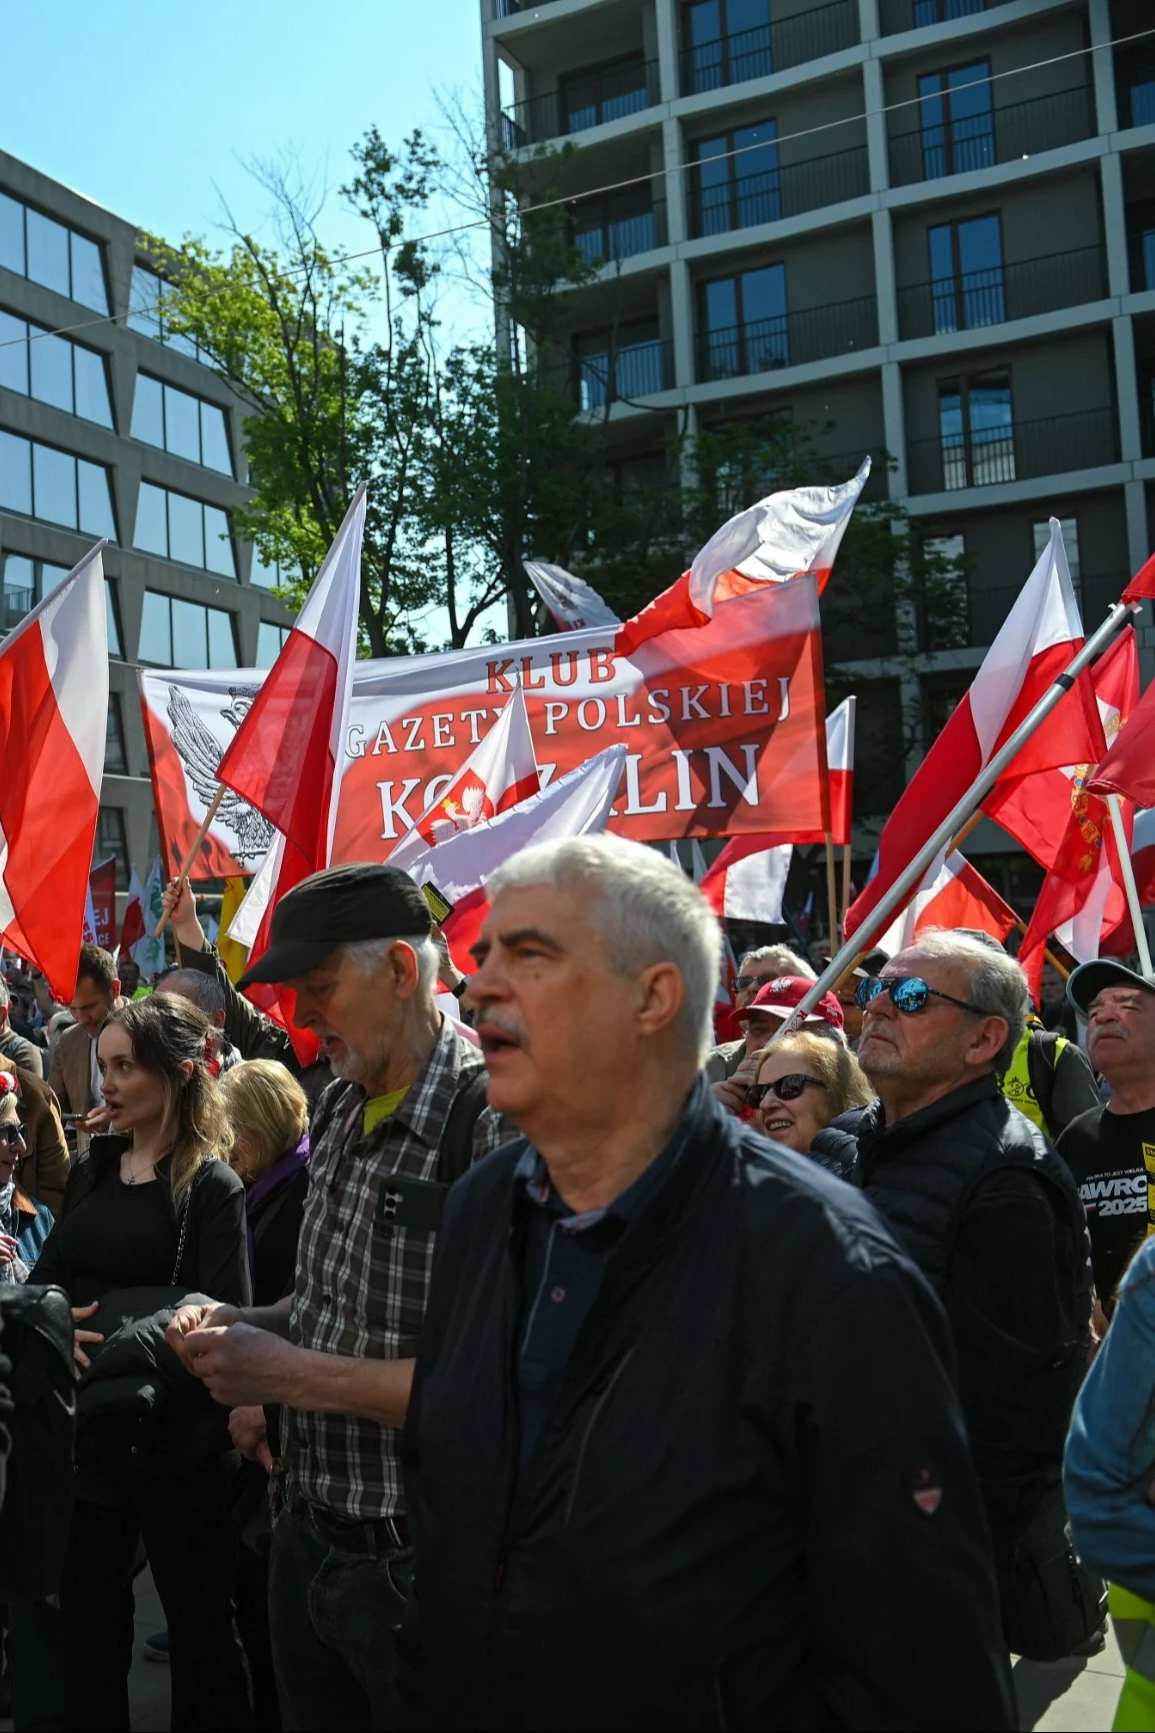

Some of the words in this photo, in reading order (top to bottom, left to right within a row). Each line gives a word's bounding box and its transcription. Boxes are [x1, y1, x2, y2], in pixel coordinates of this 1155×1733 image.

[485, 647, 617, 694] KLUB
[544, 676, 791, 735] POLSKIEJ
[1078, 1175, 1147, 1200] AWRO
[1098, 1196, 1147, 1216] 2025
